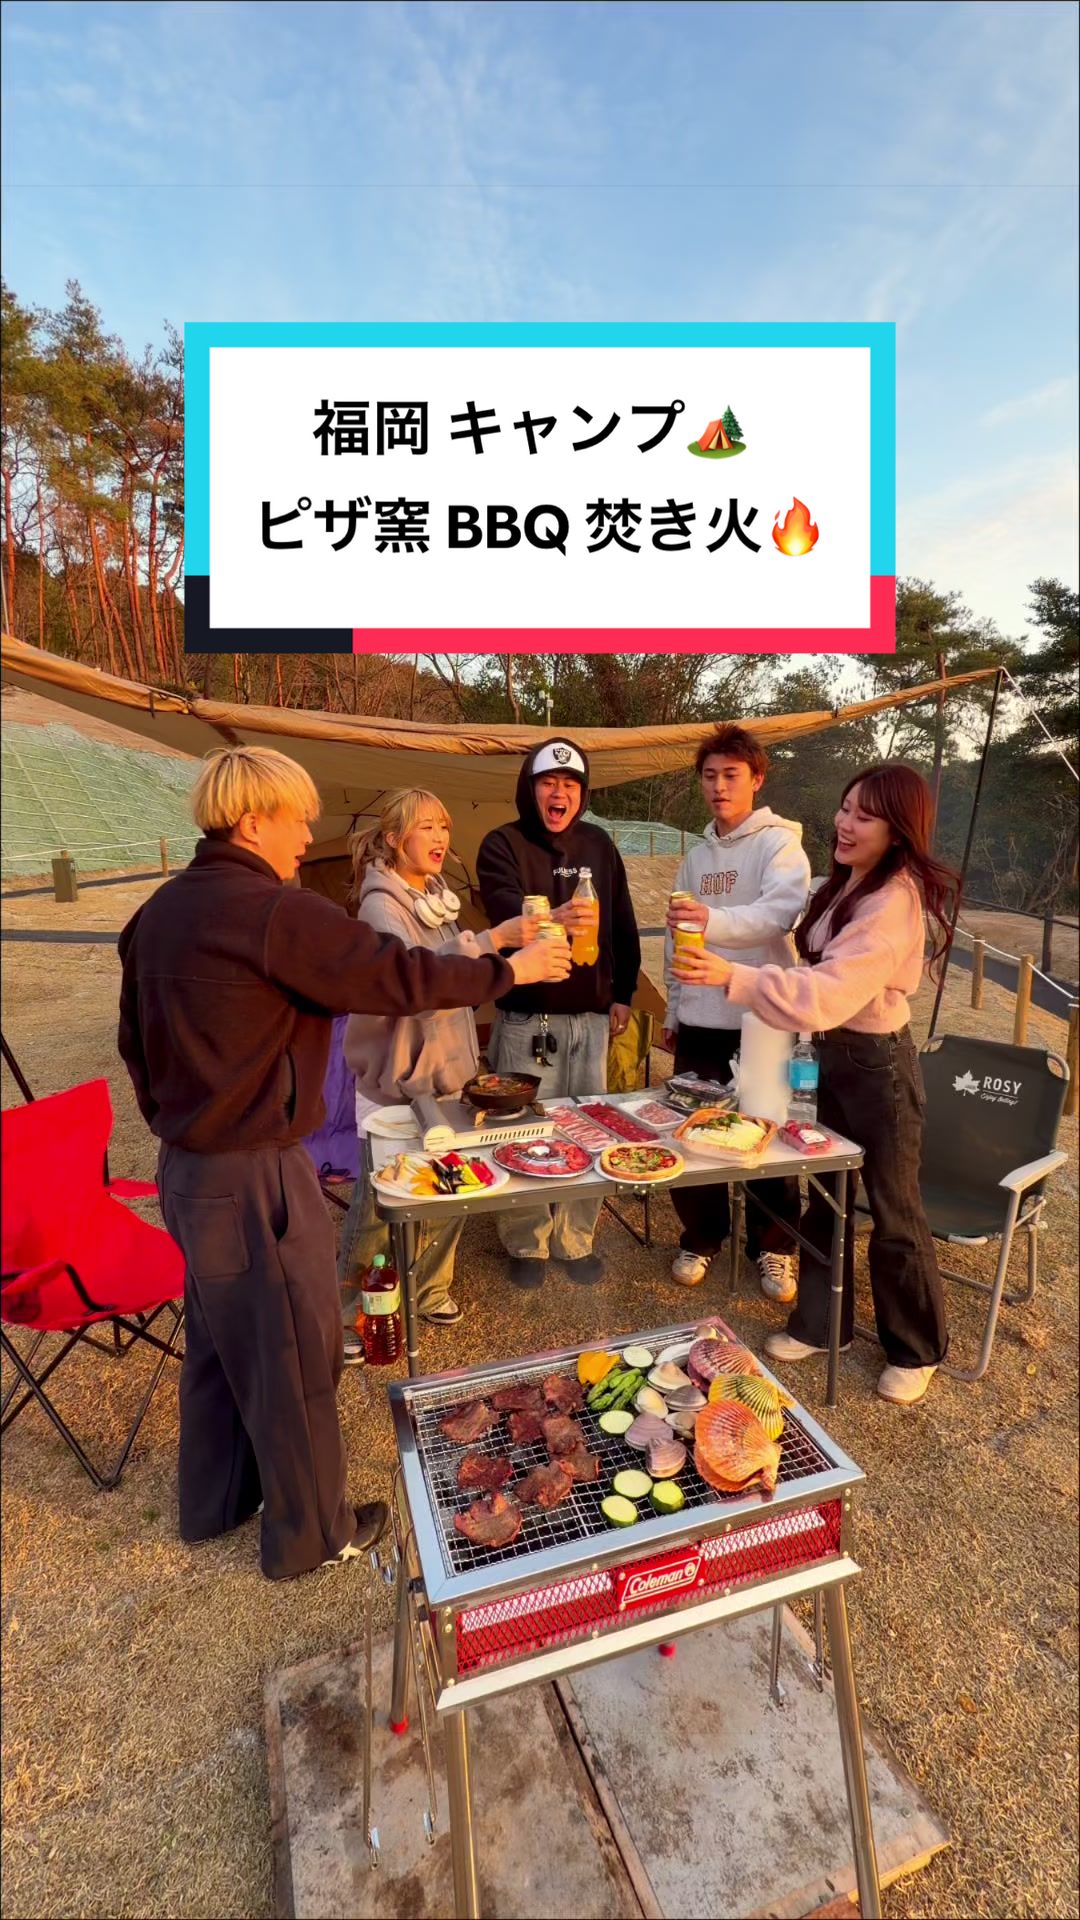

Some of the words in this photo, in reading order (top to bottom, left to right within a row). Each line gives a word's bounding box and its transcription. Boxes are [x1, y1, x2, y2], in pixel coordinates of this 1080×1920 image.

[699, 870, 739, 896] HUF
[983, 1076, 1022, 1095] ROSY
[629, 1568, 684, 1594] Coleman
